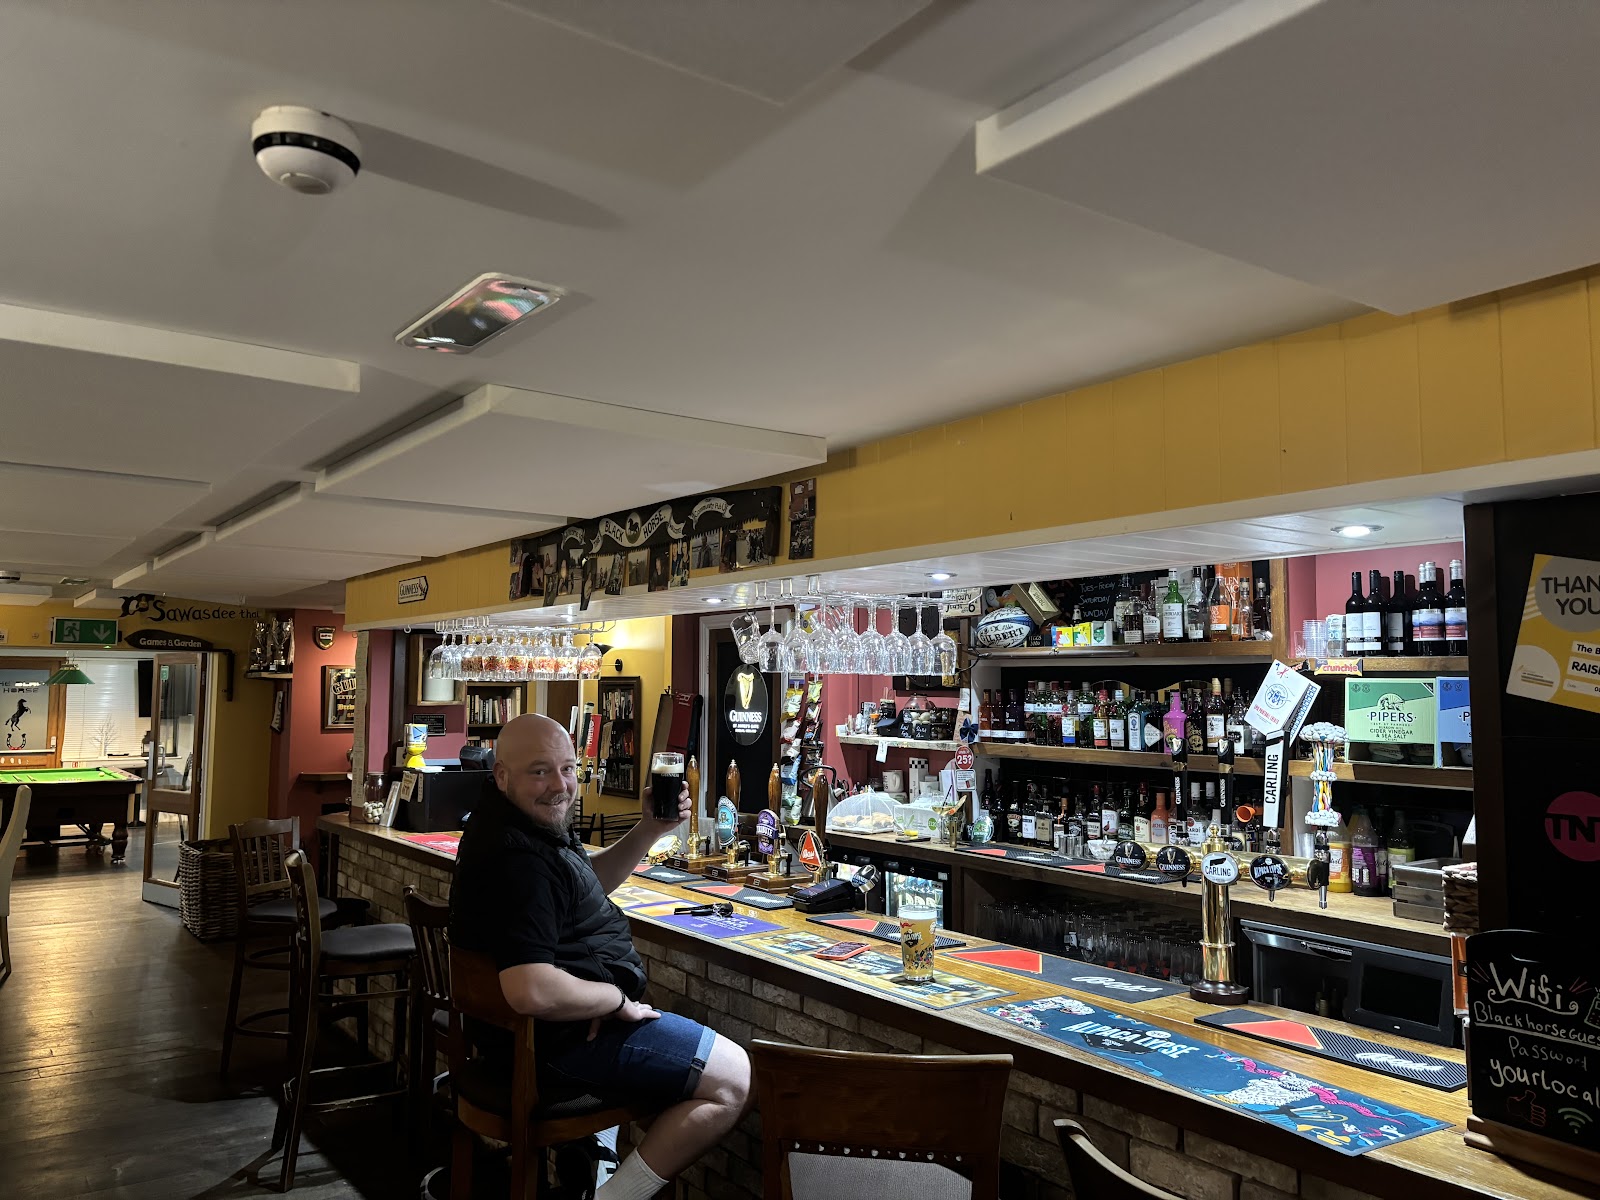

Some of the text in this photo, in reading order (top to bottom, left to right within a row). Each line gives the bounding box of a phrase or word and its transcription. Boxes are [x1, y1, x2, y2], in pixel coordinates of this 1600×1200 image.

[605, 520, 624, 542] BLACK
[400, 583, 418, 596] GUINNESS
[147, 600, 259, 622] Sawasdee thai
[980, 627, 1025, 643] GILBERT
[140, 638, 201, 648] Games & Garden
[1576, 643, 1593, 654] The
[1322, 664, 1358, 673] crunchie
[729, 710, 762, 723] GUINNESS
[1369, 711, 1414, 722] PIPERS
[956, 754, 972, 765] 25?
[1264, 754, 1279, 804] CARLING
[1115, 856, 1142, 865] GUINNESS
[1158, 863, 1186, 871] GUINNESS
[1204, 865, 1232, 877] CARLING
[1490, 961, 1563, 1010] Wifi
